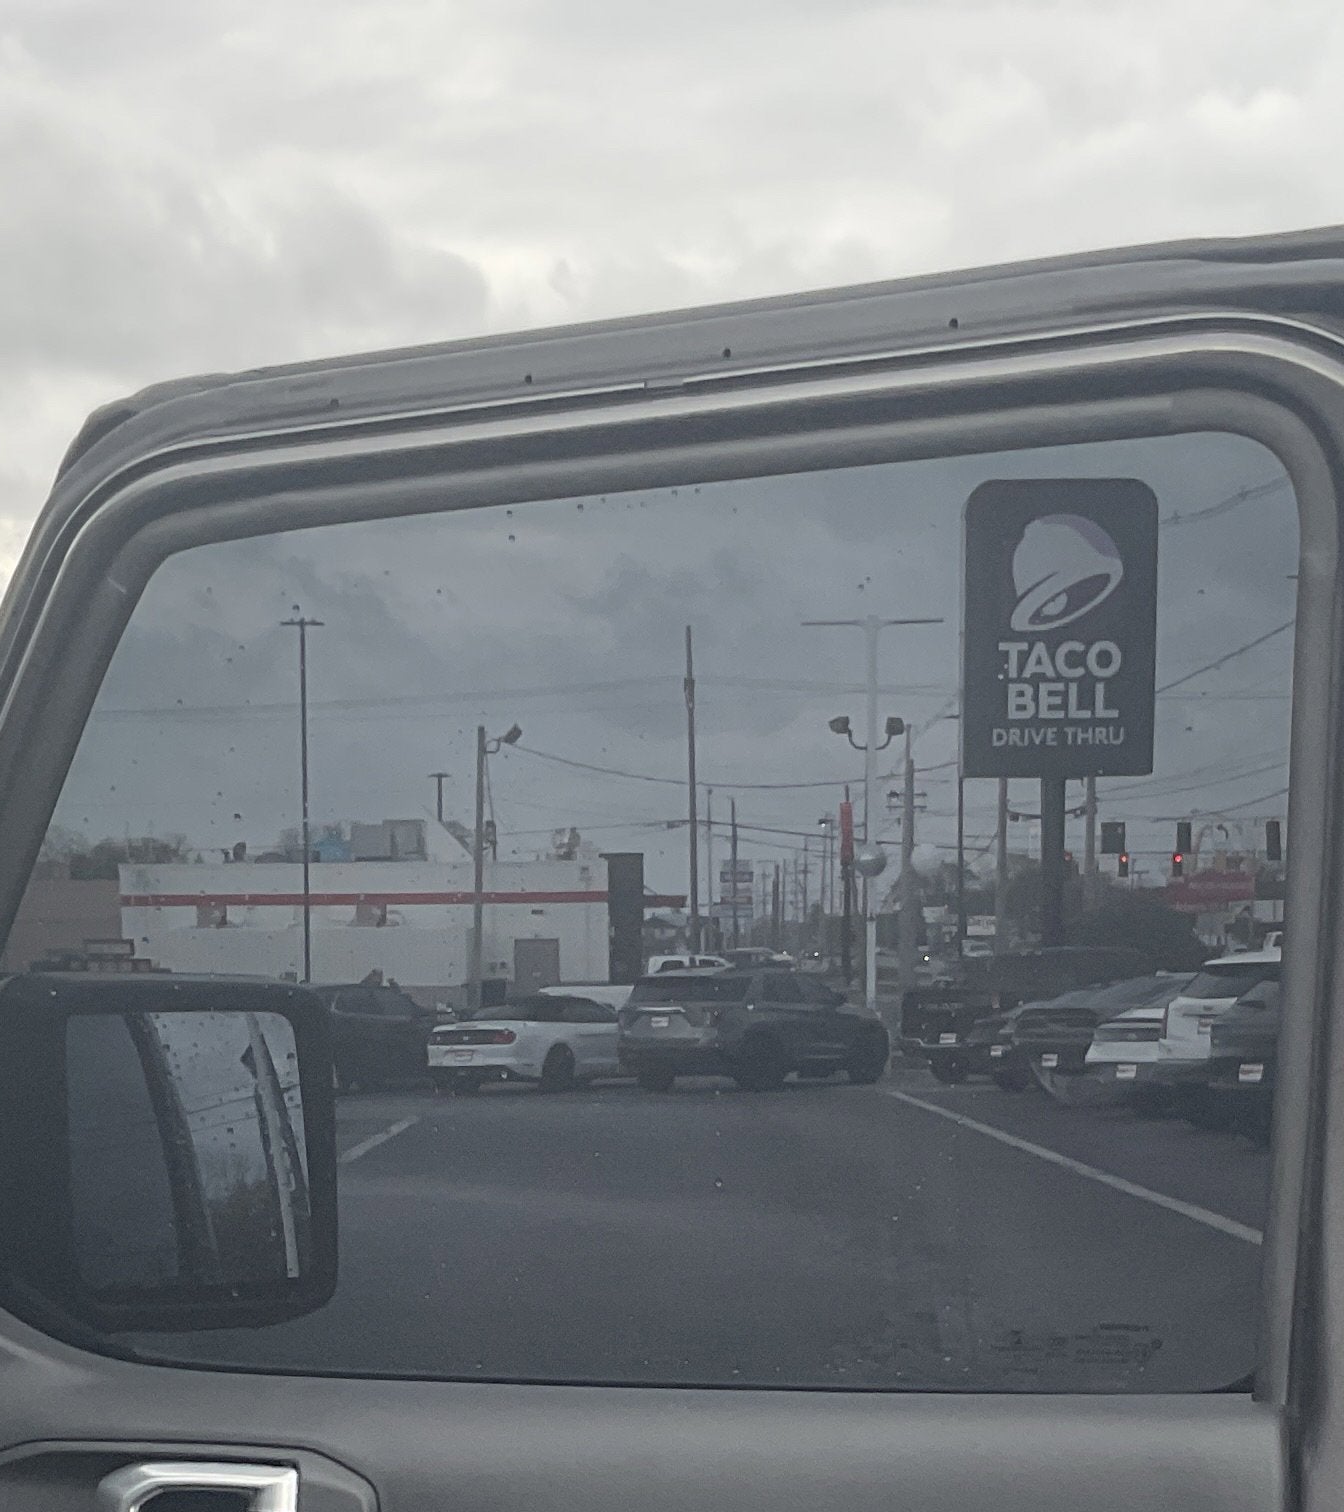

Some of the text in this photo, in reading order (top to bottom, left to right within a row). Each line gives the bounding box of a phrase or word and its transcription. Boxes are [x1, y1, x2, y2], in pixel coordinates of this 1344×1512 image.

[998, 640, 1122, 679] TACO
[1007, 681, 1119, 719] BELL
[991, 726, 1125, 747] DRIVE THRU
